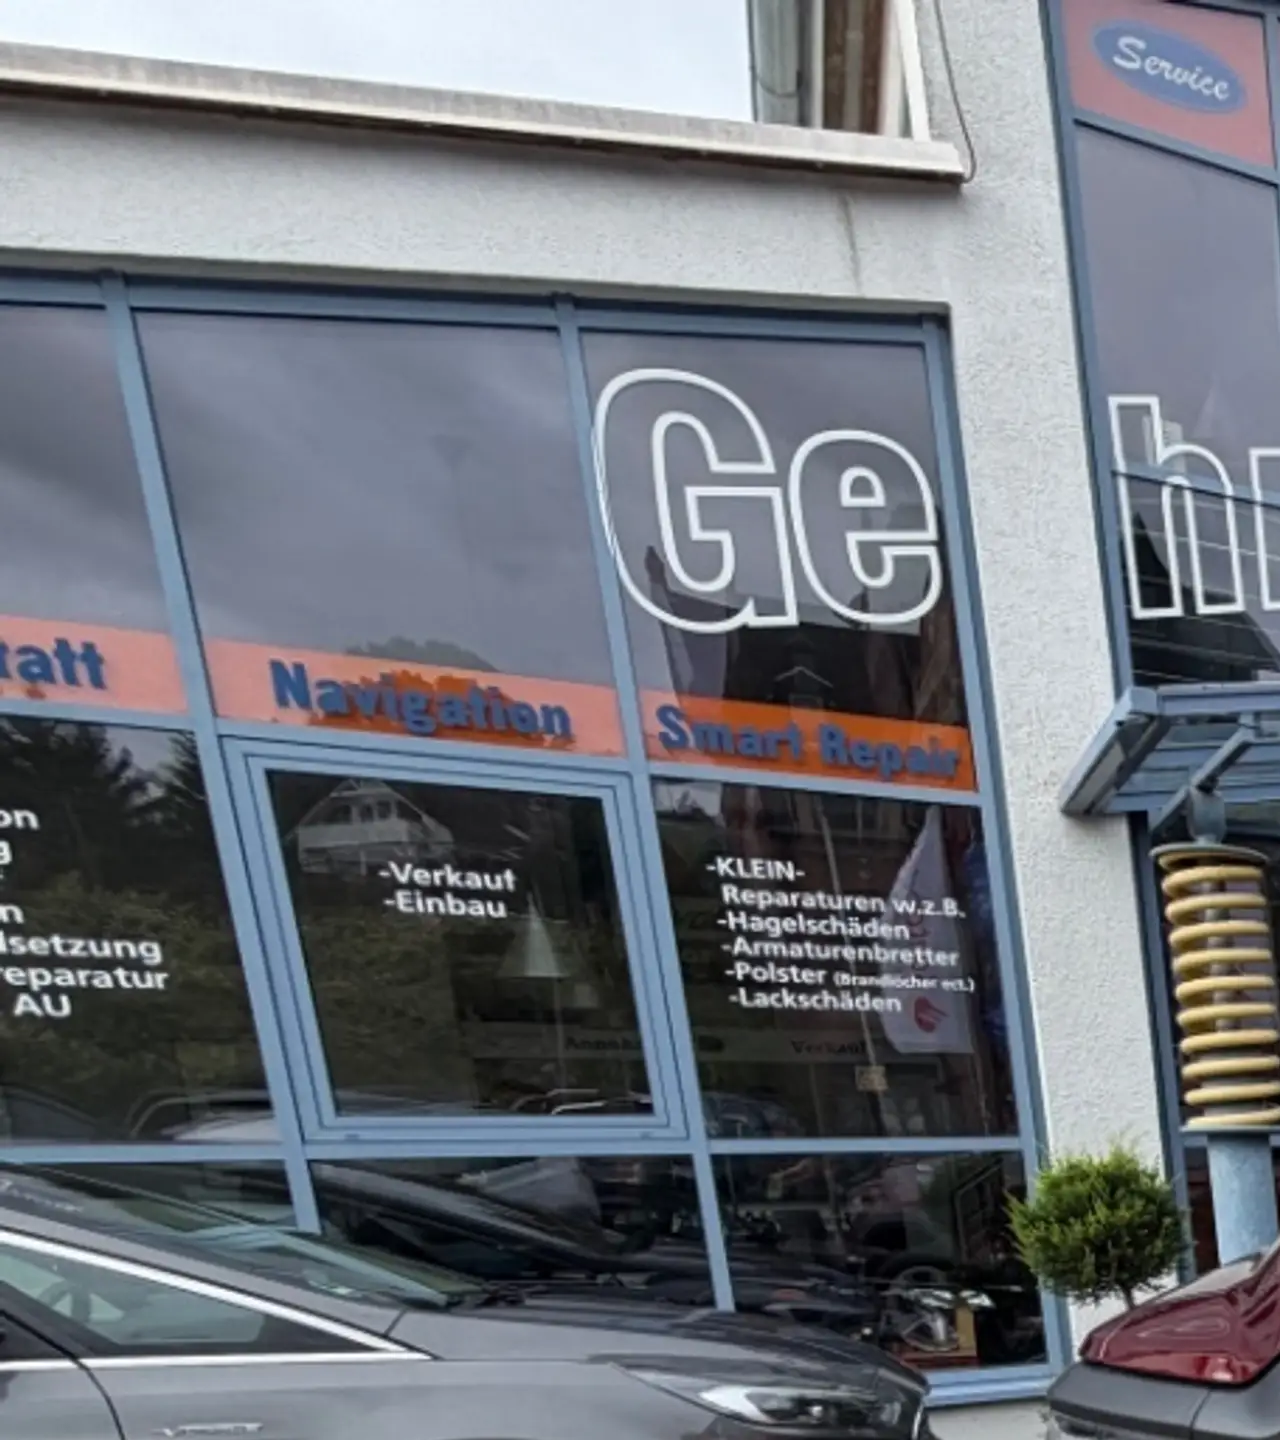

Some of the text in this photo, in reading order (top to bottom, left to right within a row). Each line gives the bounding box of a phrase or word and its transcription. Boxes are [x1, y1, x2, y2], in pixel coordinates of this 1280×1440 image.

[1112, 35, 1230, 101] Service
[594, 367, 943, 634] Ge
[269, 658, 573, 738] Navigation
[655, 704, 960, 779] Smart Repair
[379, 860, 517, 893] -Verkauf
[383, 889, 508, 919] -Einbau
[721, 884, 886, 912] Reparaturen
[0, 930, 163, 966] setzung
[13, 992, 72, 1018] AU
